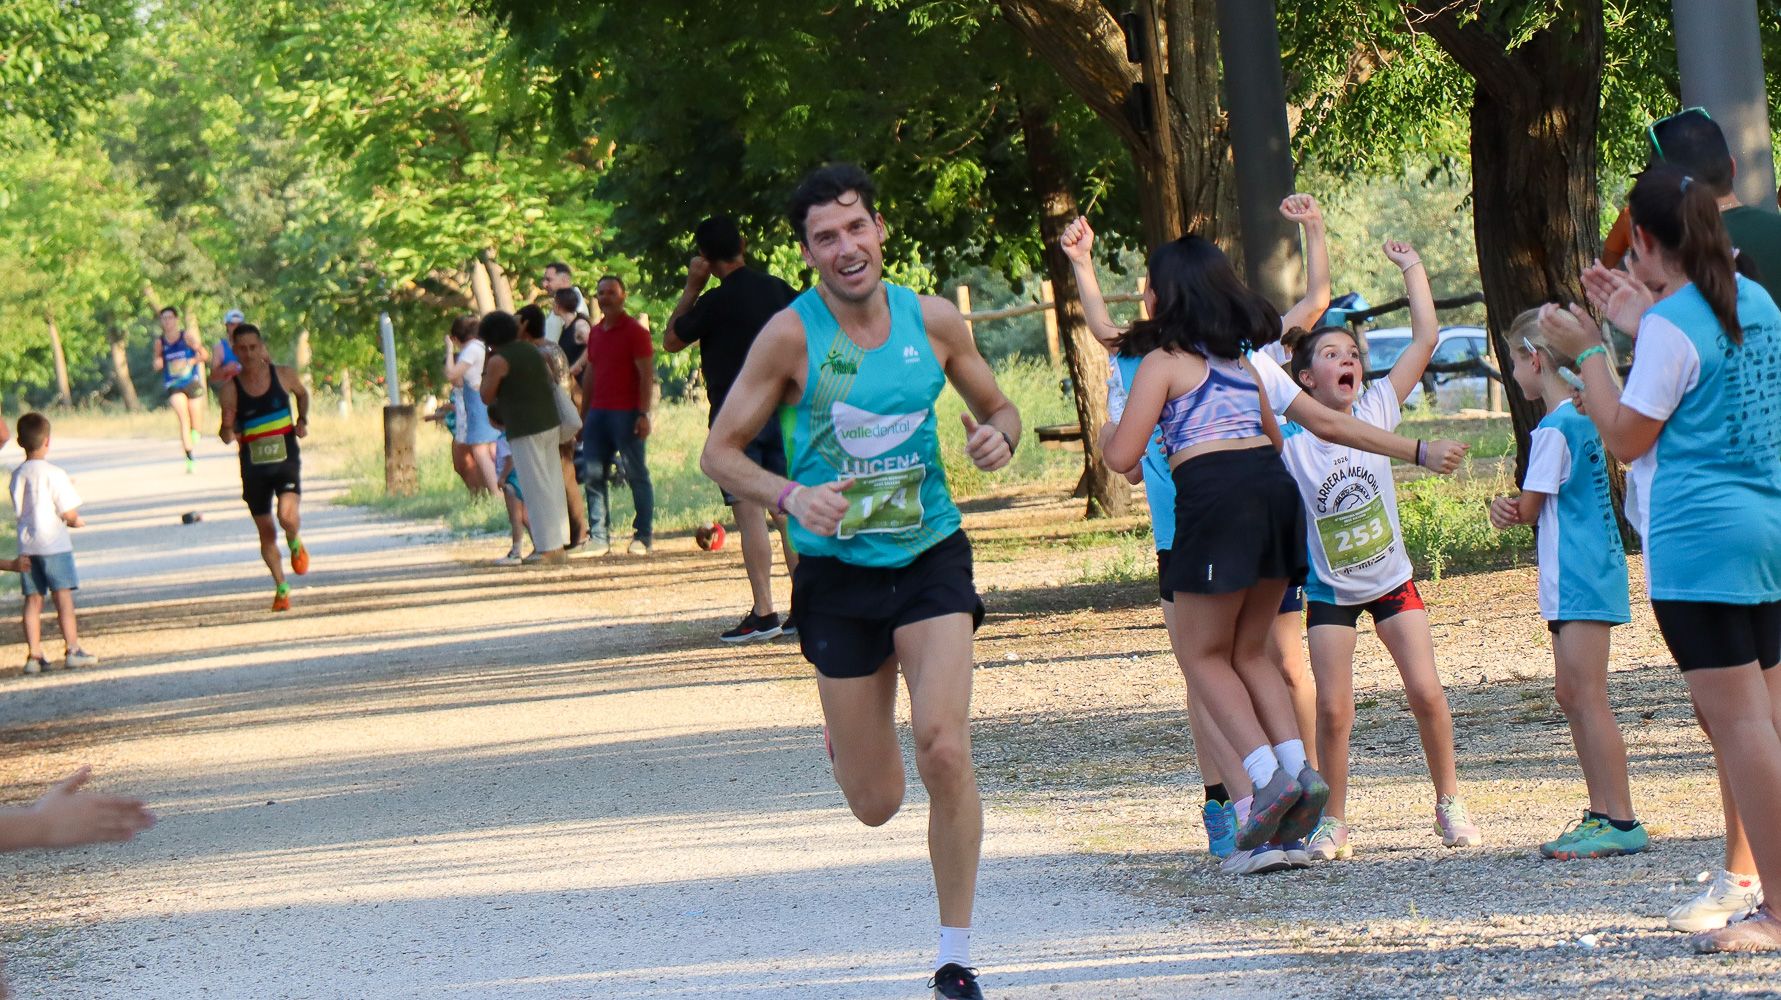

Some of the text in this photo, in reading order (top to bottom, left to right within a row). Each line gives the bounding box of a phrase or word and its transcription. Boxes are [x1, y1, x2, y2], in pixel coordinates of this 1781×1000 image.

[841, 420, 910, 440] valledental
[841, 452, 920, 475] LUCENA
[1333, 456, 1349, 466] 2026
[862, 487, 908, 519] 14
[1317, 468, 1347, 514] CARRERA
[1335, 517, 1384, 553] 253
